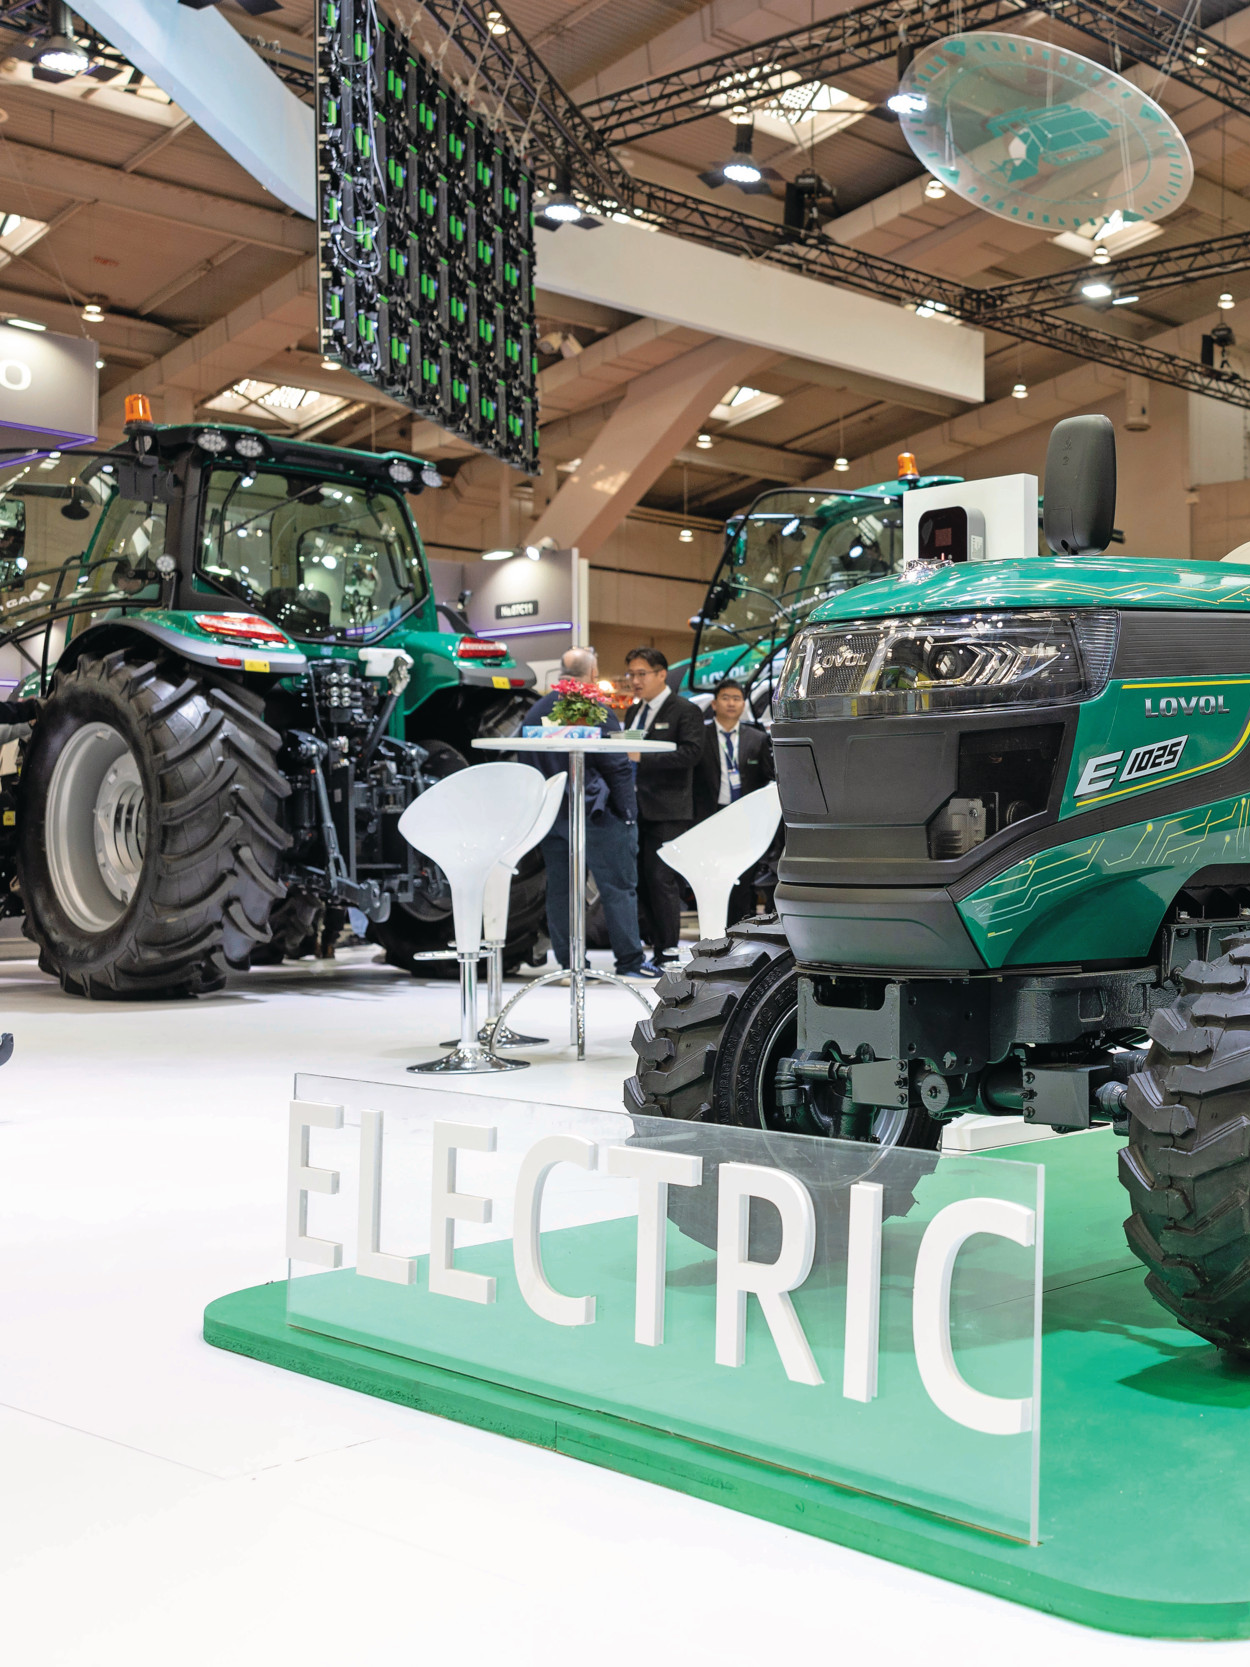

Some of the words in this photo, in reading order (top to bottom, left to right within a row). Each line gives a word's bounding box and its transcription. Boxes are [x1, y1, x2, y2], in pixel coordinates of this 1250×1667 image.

[1144, 694, 1230, 718] LOVOL
[1073, 750, 1125, 798] E
[1126, 740, 1183, 776] 1025
[285, 1099, 1036, 1436] ELECTRIC
